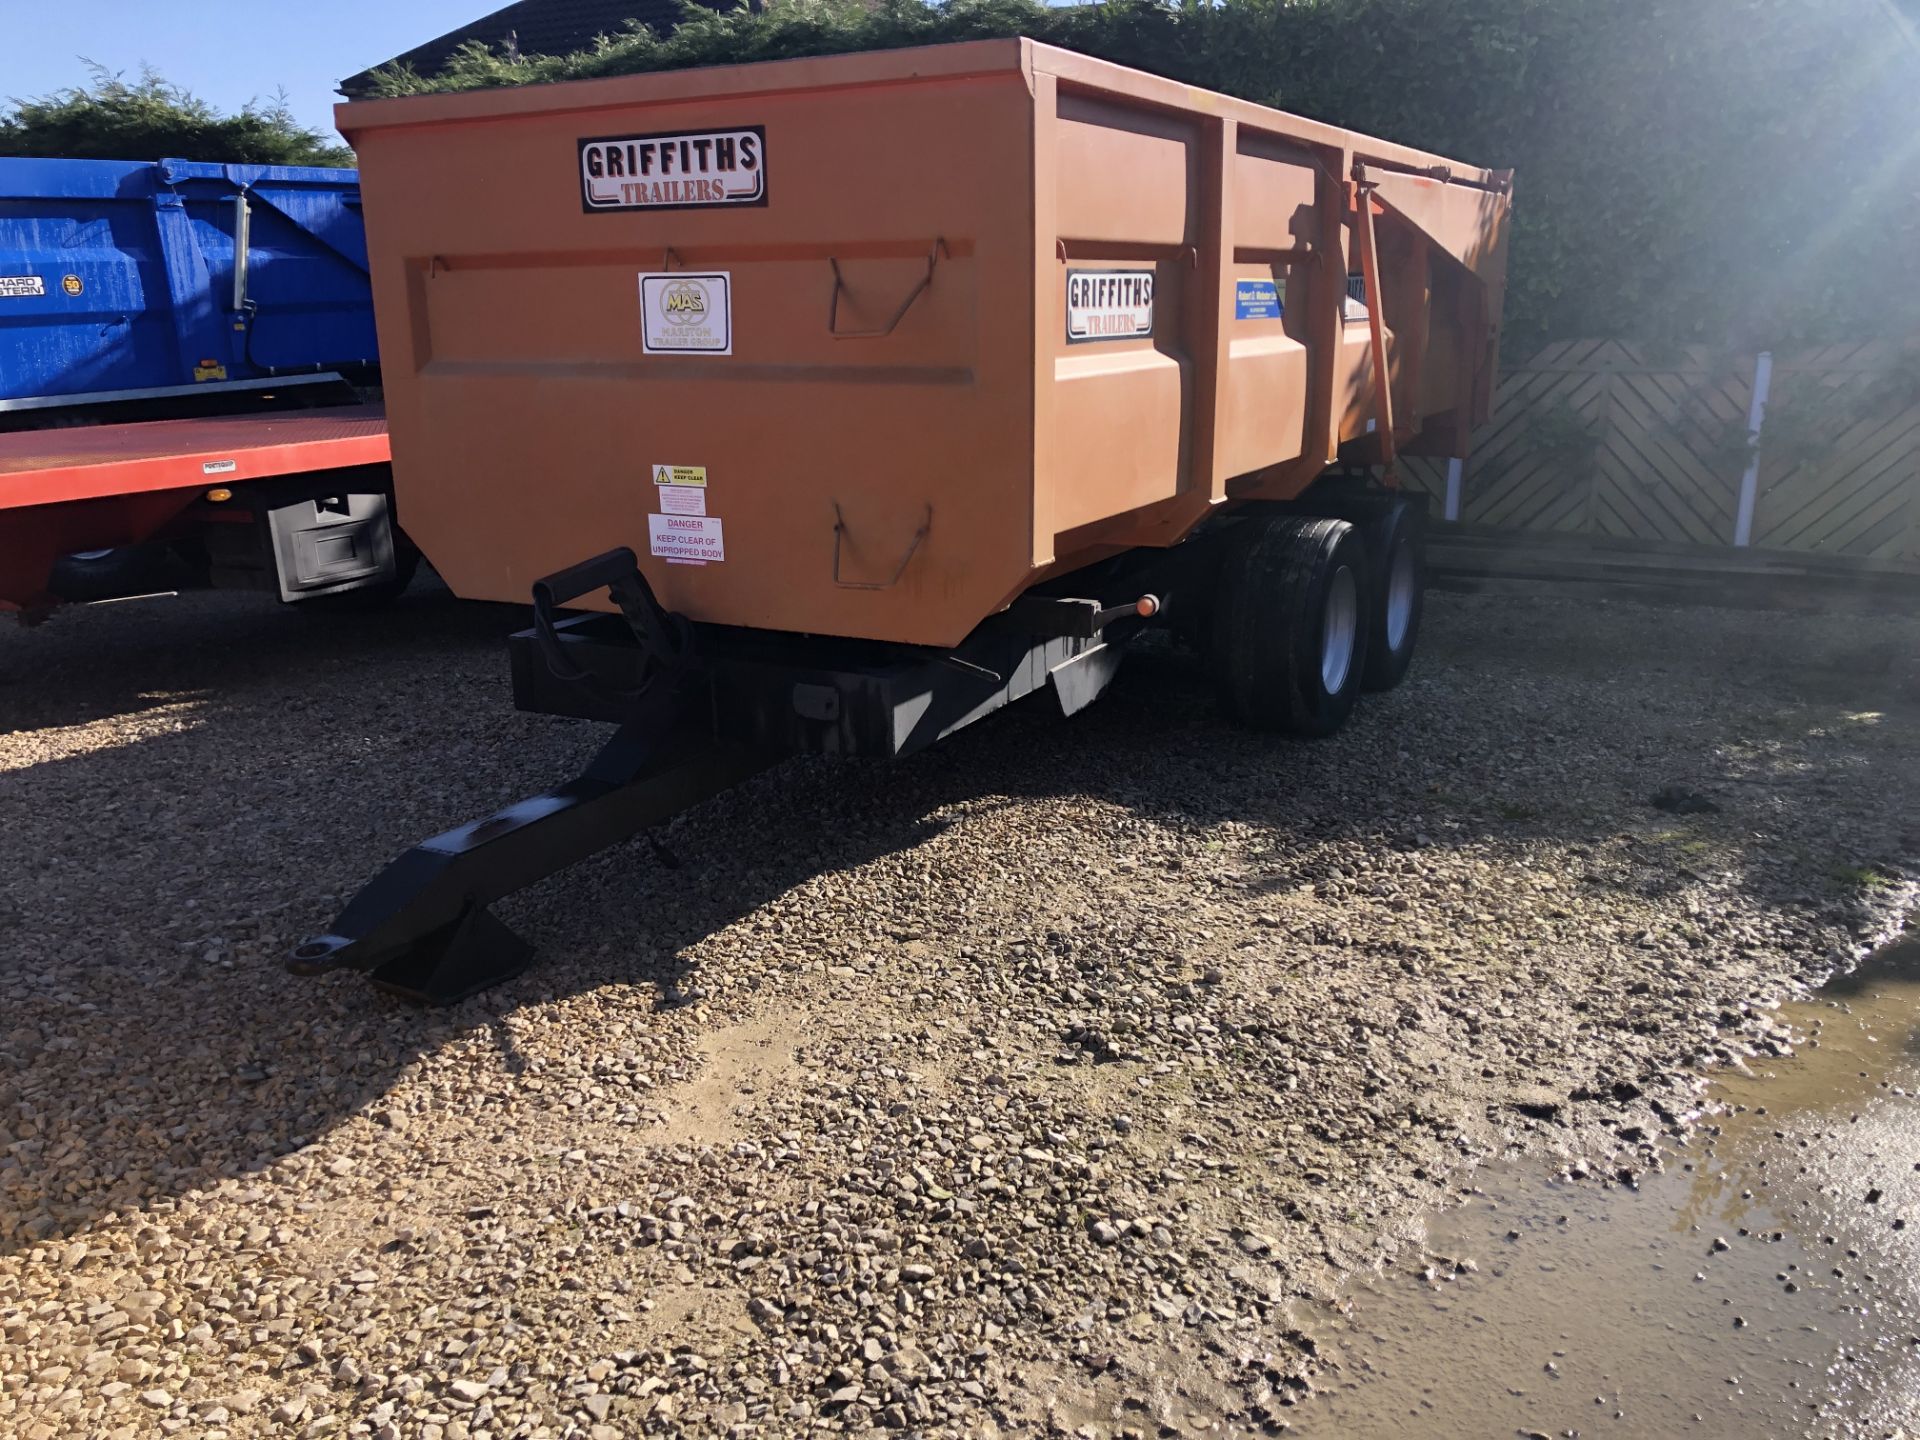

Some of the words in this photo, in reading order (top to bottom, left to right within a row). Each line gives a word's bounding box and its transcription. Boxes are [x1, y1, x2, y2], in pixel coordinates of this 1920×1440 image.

[586, 136, 758, 179] GRIFFITHS
[621, 178, 725, 204] TRAILERS
[666, 292, 704, 311] MAS
[1070, 277, 1150, 308] GRIFFITHS
[1087, 313, 1136, 335] TRAILERS
[667, 518, 703, 529] DANGER
[656, 534, 677, 543] KEEP
[678, 536, 704, 545] CLEAR
[705, 538, 716, 546] OF
[652, 546, 700, 556] UNPROPPED
[701, 549, 723, 558] BODY
